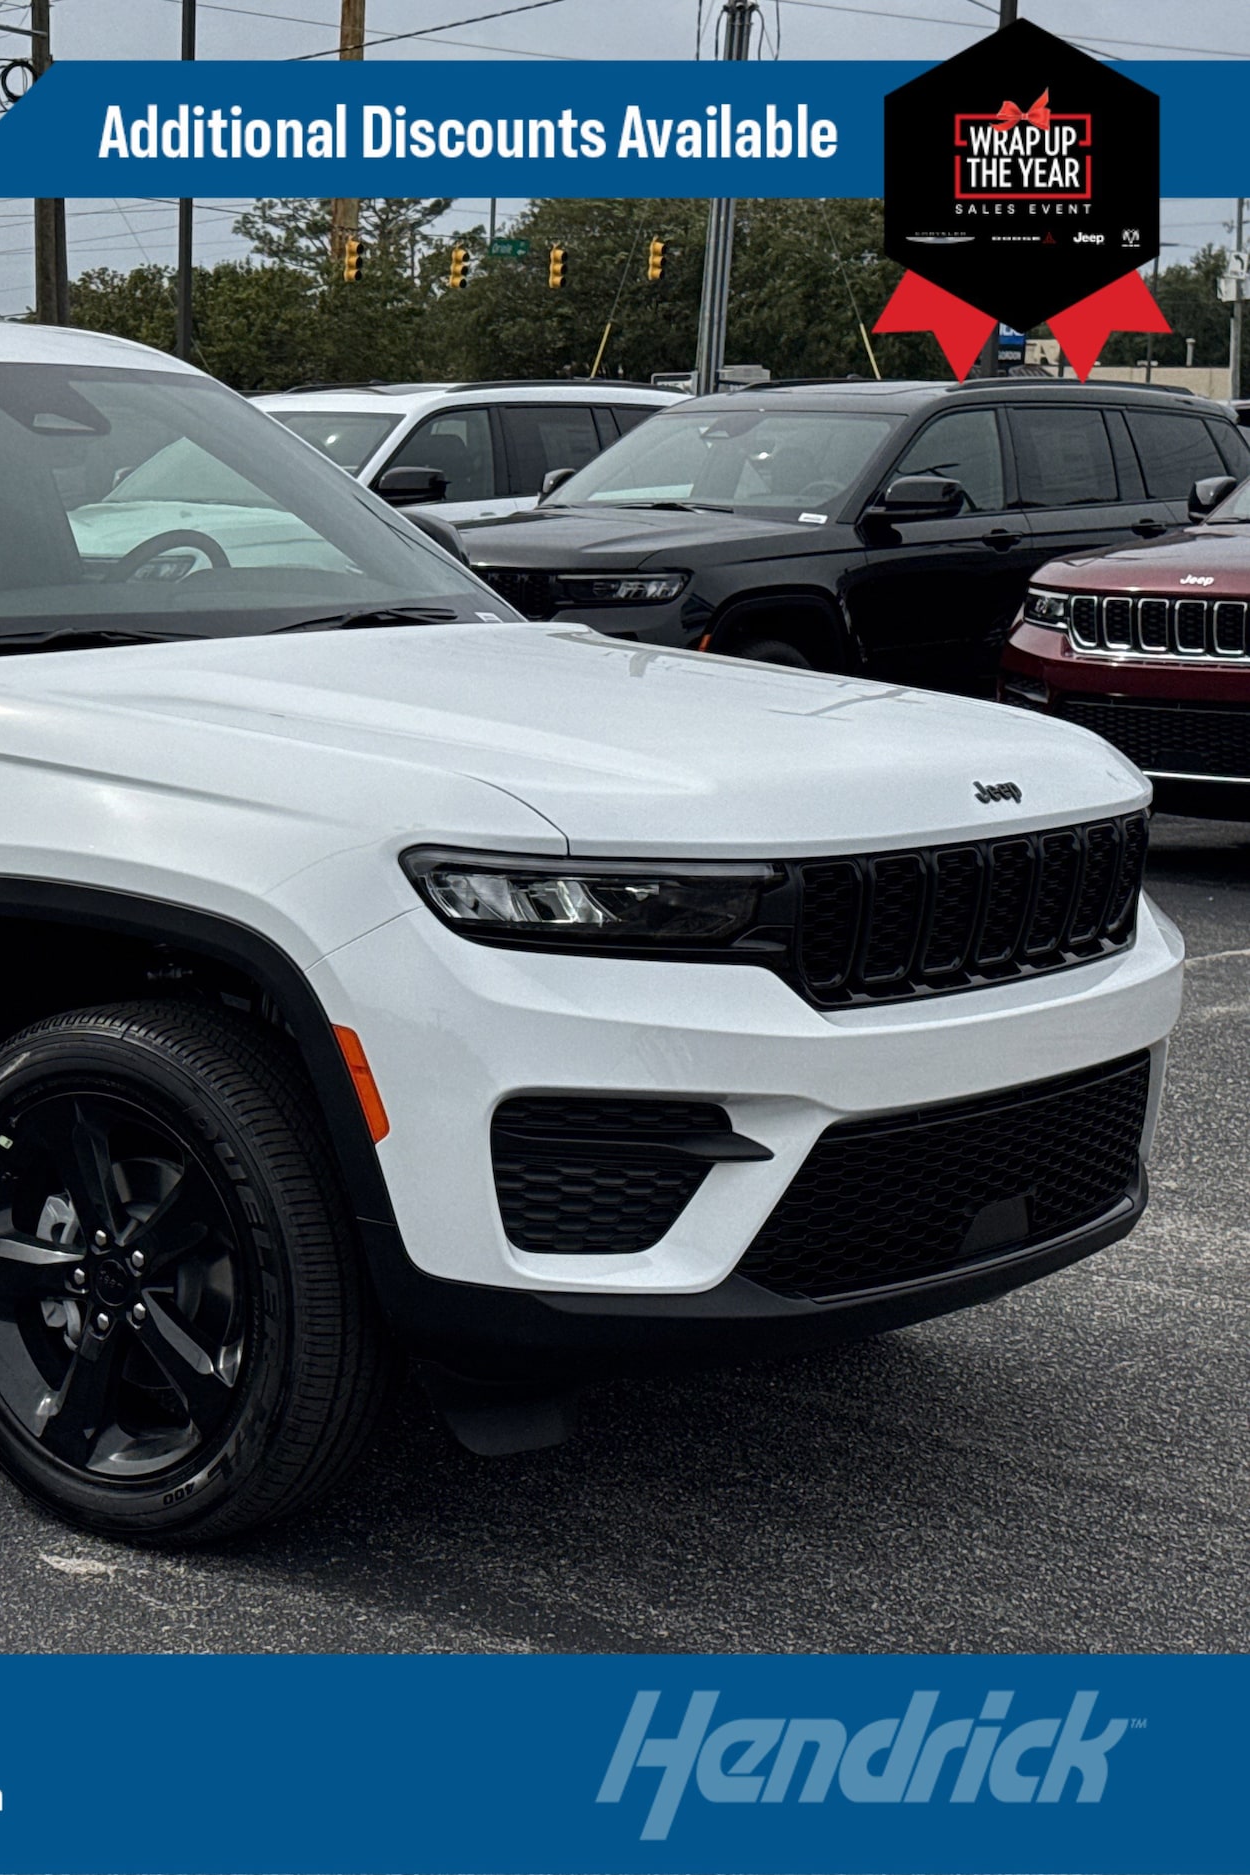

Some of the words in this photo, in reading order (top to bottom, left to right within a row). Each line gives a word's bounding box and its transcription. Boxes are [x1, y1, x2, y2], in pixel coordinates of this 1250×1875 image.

[1180, 574, 1215, 587] Jeep
[972, 781, 1023, 805] Jeep
[162, 1481, 196, 1506] 400
